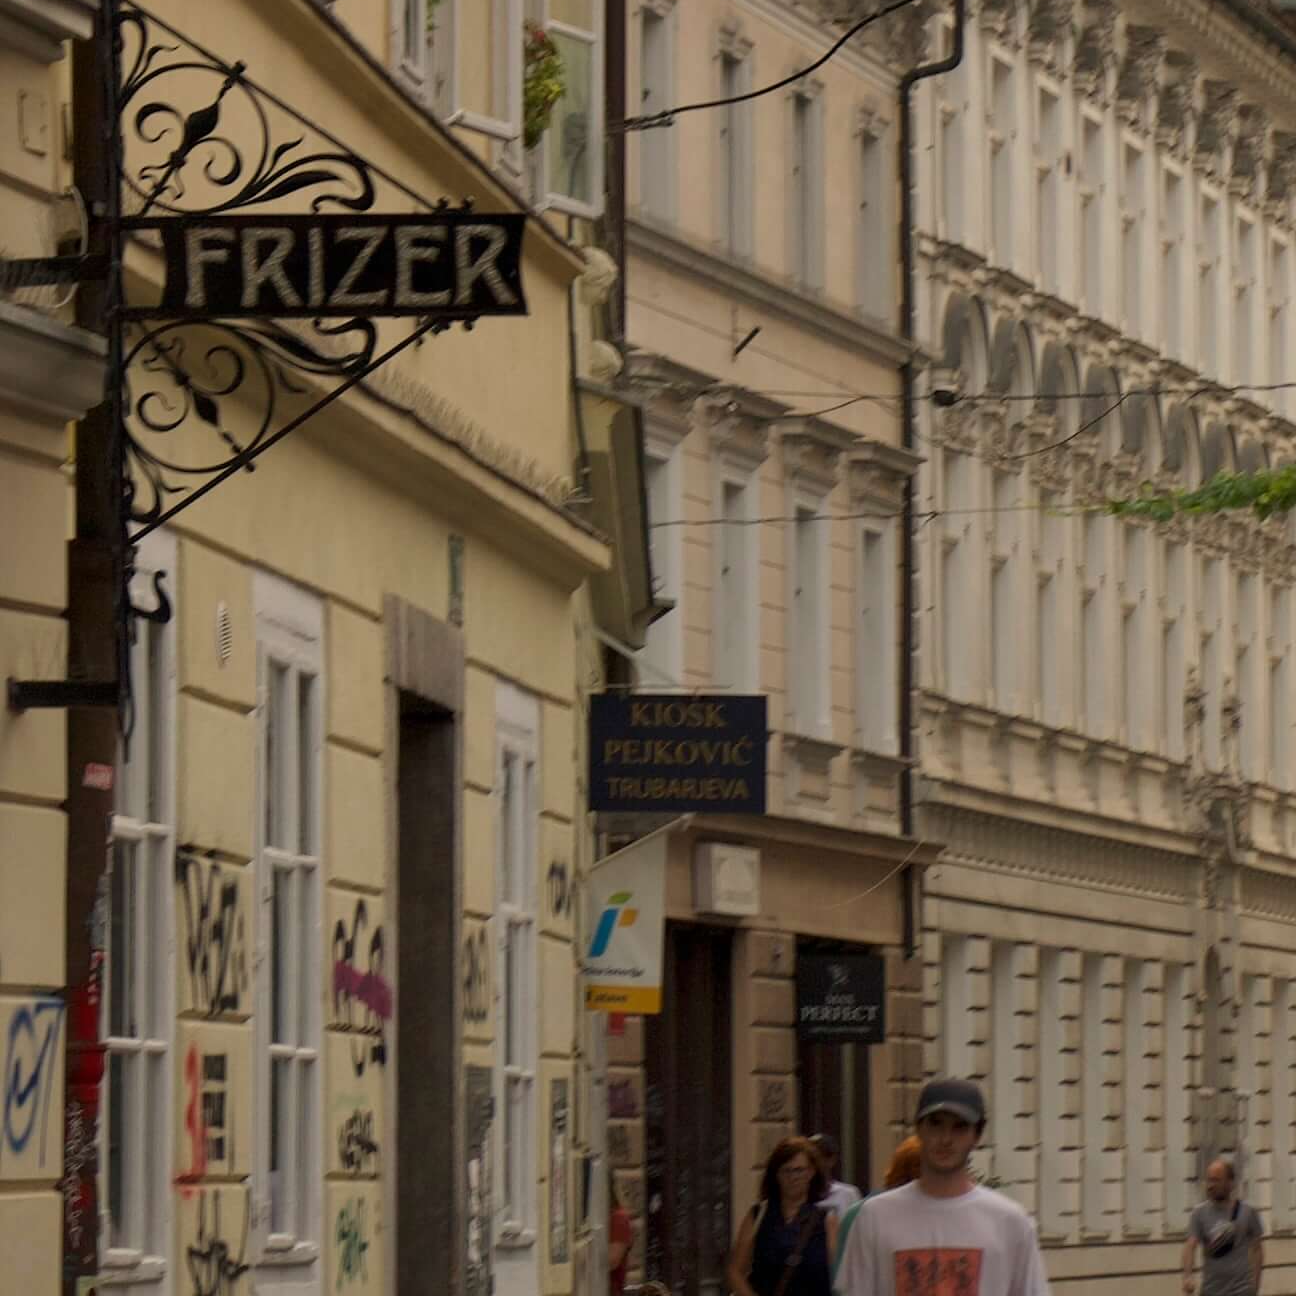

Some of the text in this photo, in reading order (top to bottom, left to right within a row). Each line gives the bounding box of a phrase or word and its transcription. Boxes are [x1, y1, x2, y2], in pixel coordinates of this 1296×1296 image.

[184, 224, 518, 307] FRIZER
[630, 702, 728, 728] KIOSK
[603, 735, 753, 766] PEJKOVIĆ
[605, 777, 751, 800] TRUBARJEVA
